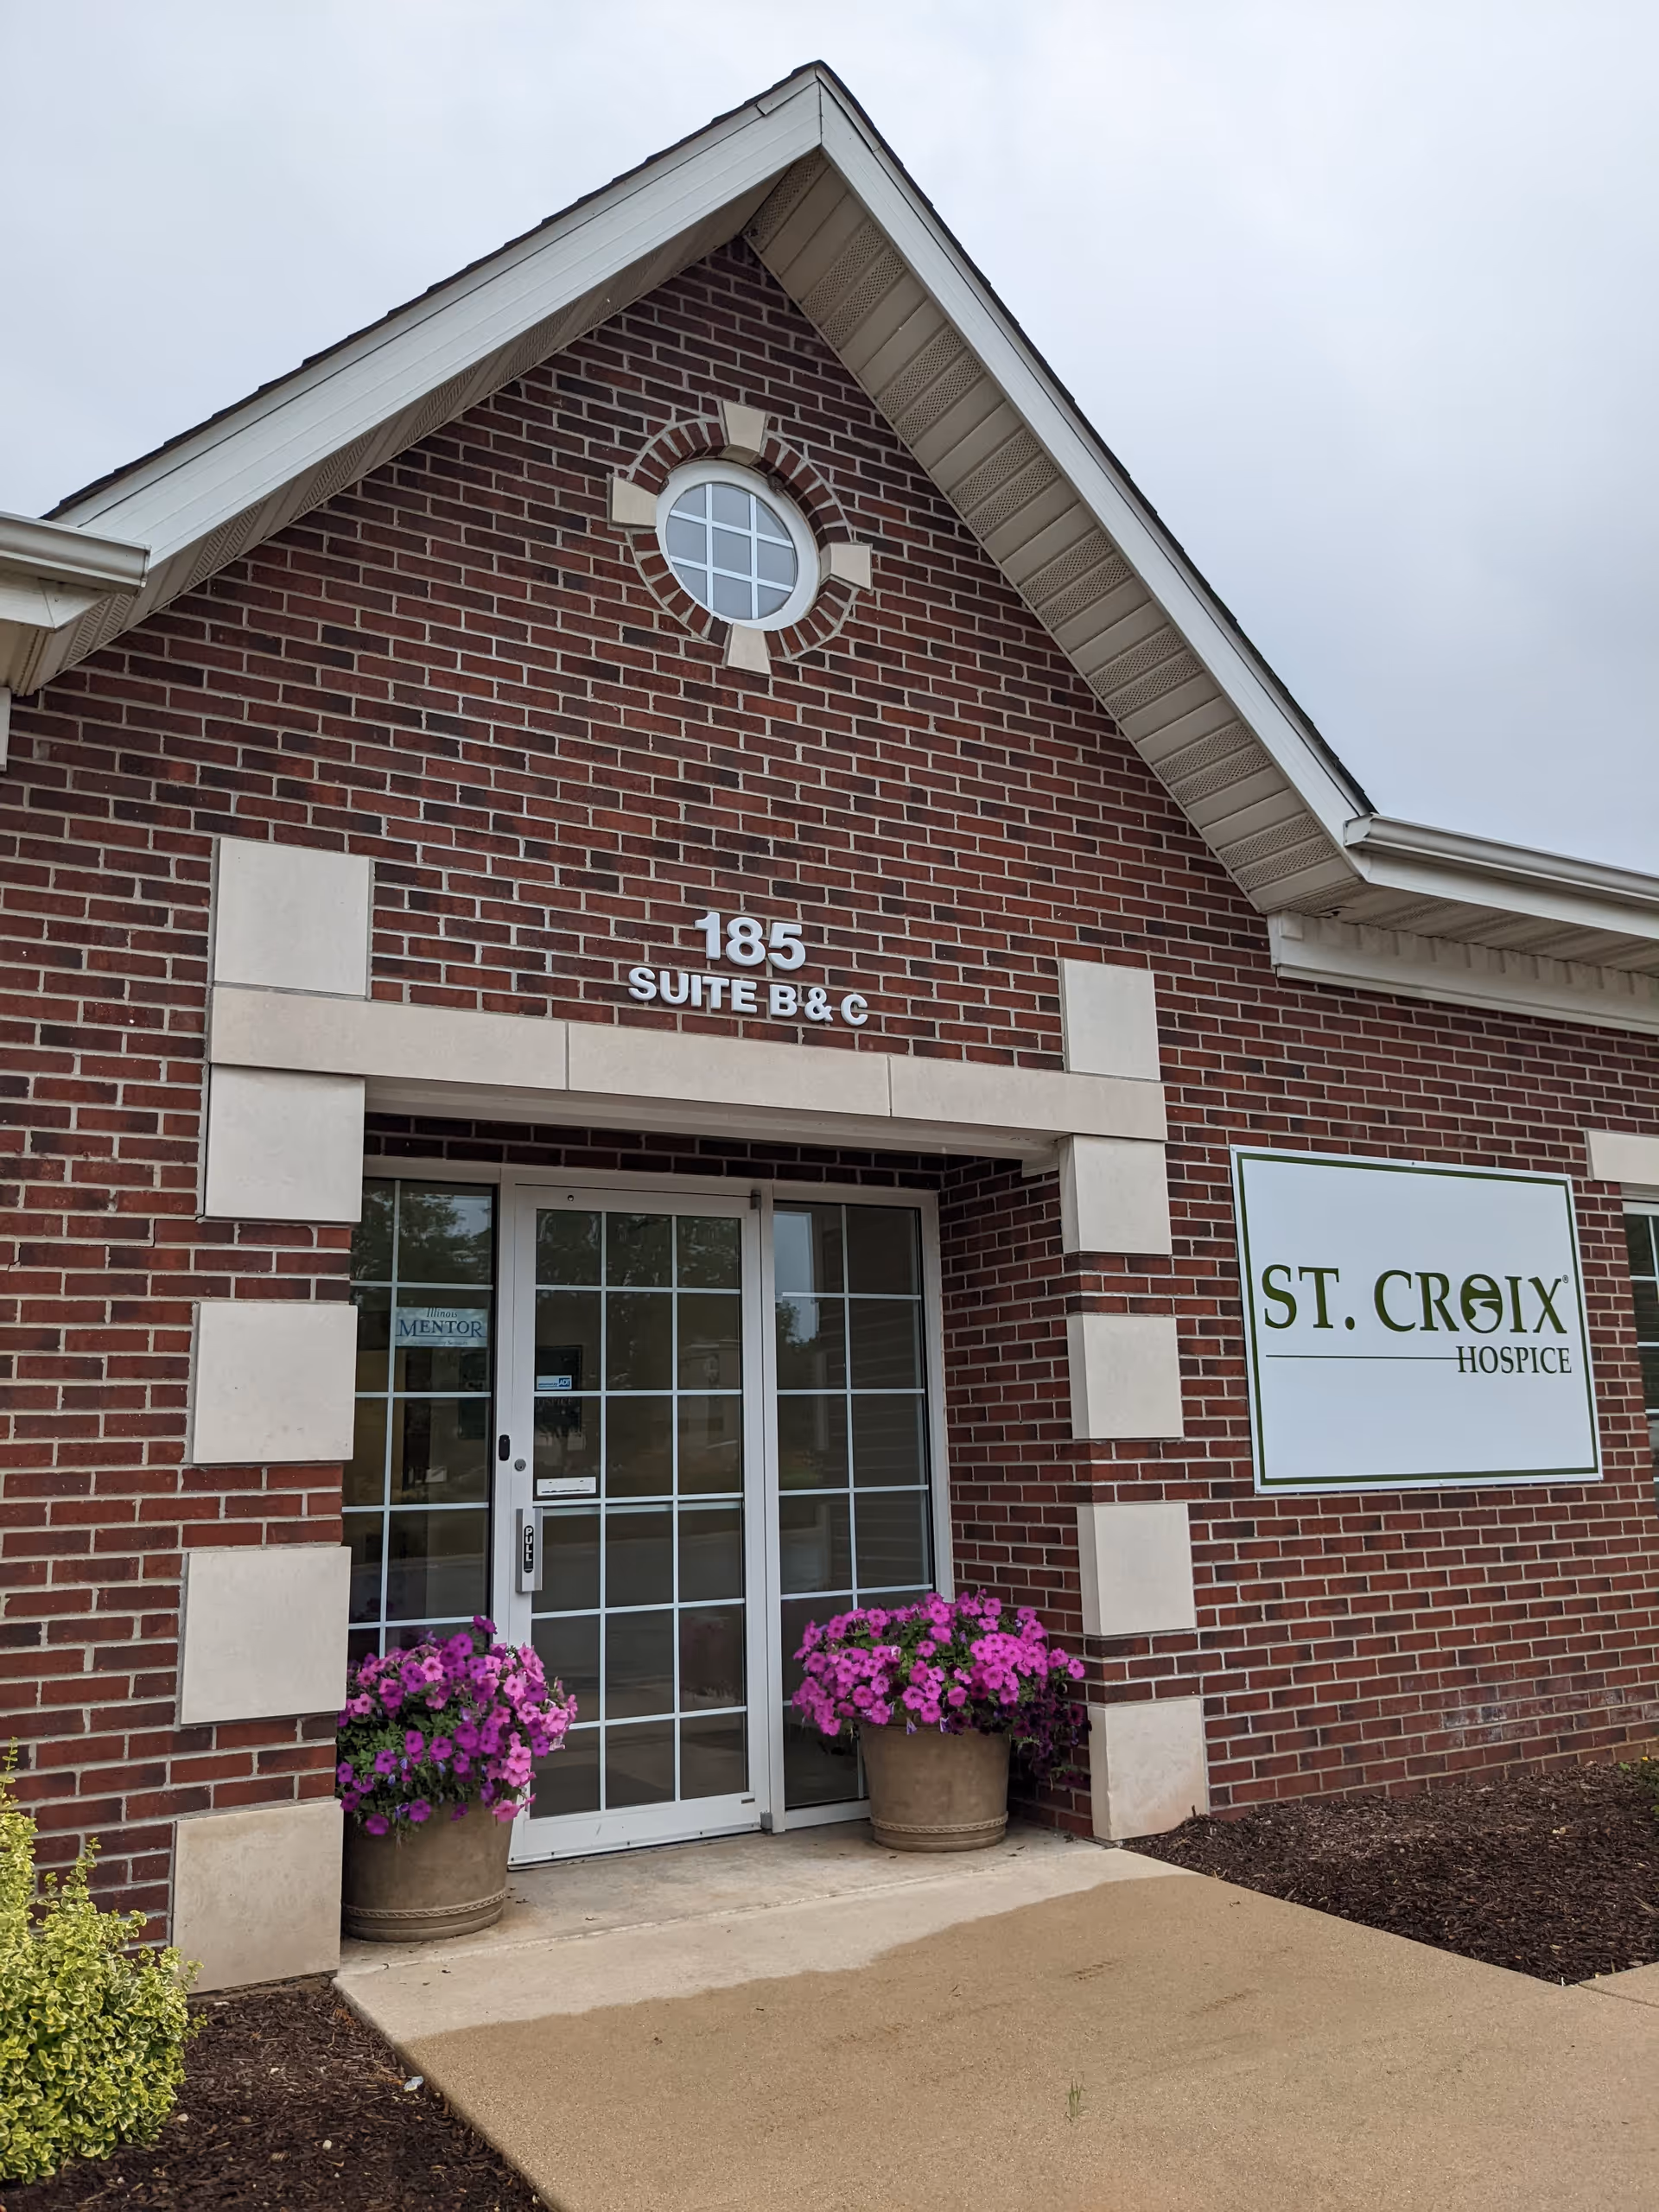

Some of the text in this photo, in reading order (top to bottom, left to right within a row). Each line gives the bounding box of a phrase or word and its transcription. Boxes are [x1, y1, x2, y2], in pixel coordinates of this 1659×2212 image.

[695, 911, 806, 972] 185
[628, 967, 758, 1014] SUITE
[426, 1307, 458, 1319] Illinois
[1262, 1263, 1356, 1331] ST.
[399, 1319, 484, 1338] MENTOR
[1455, 1345, 1573, 1375] HOSPICE
[559, 1378, 570, 1387] ADT
[524, 1527, 533, 1562] PULL
